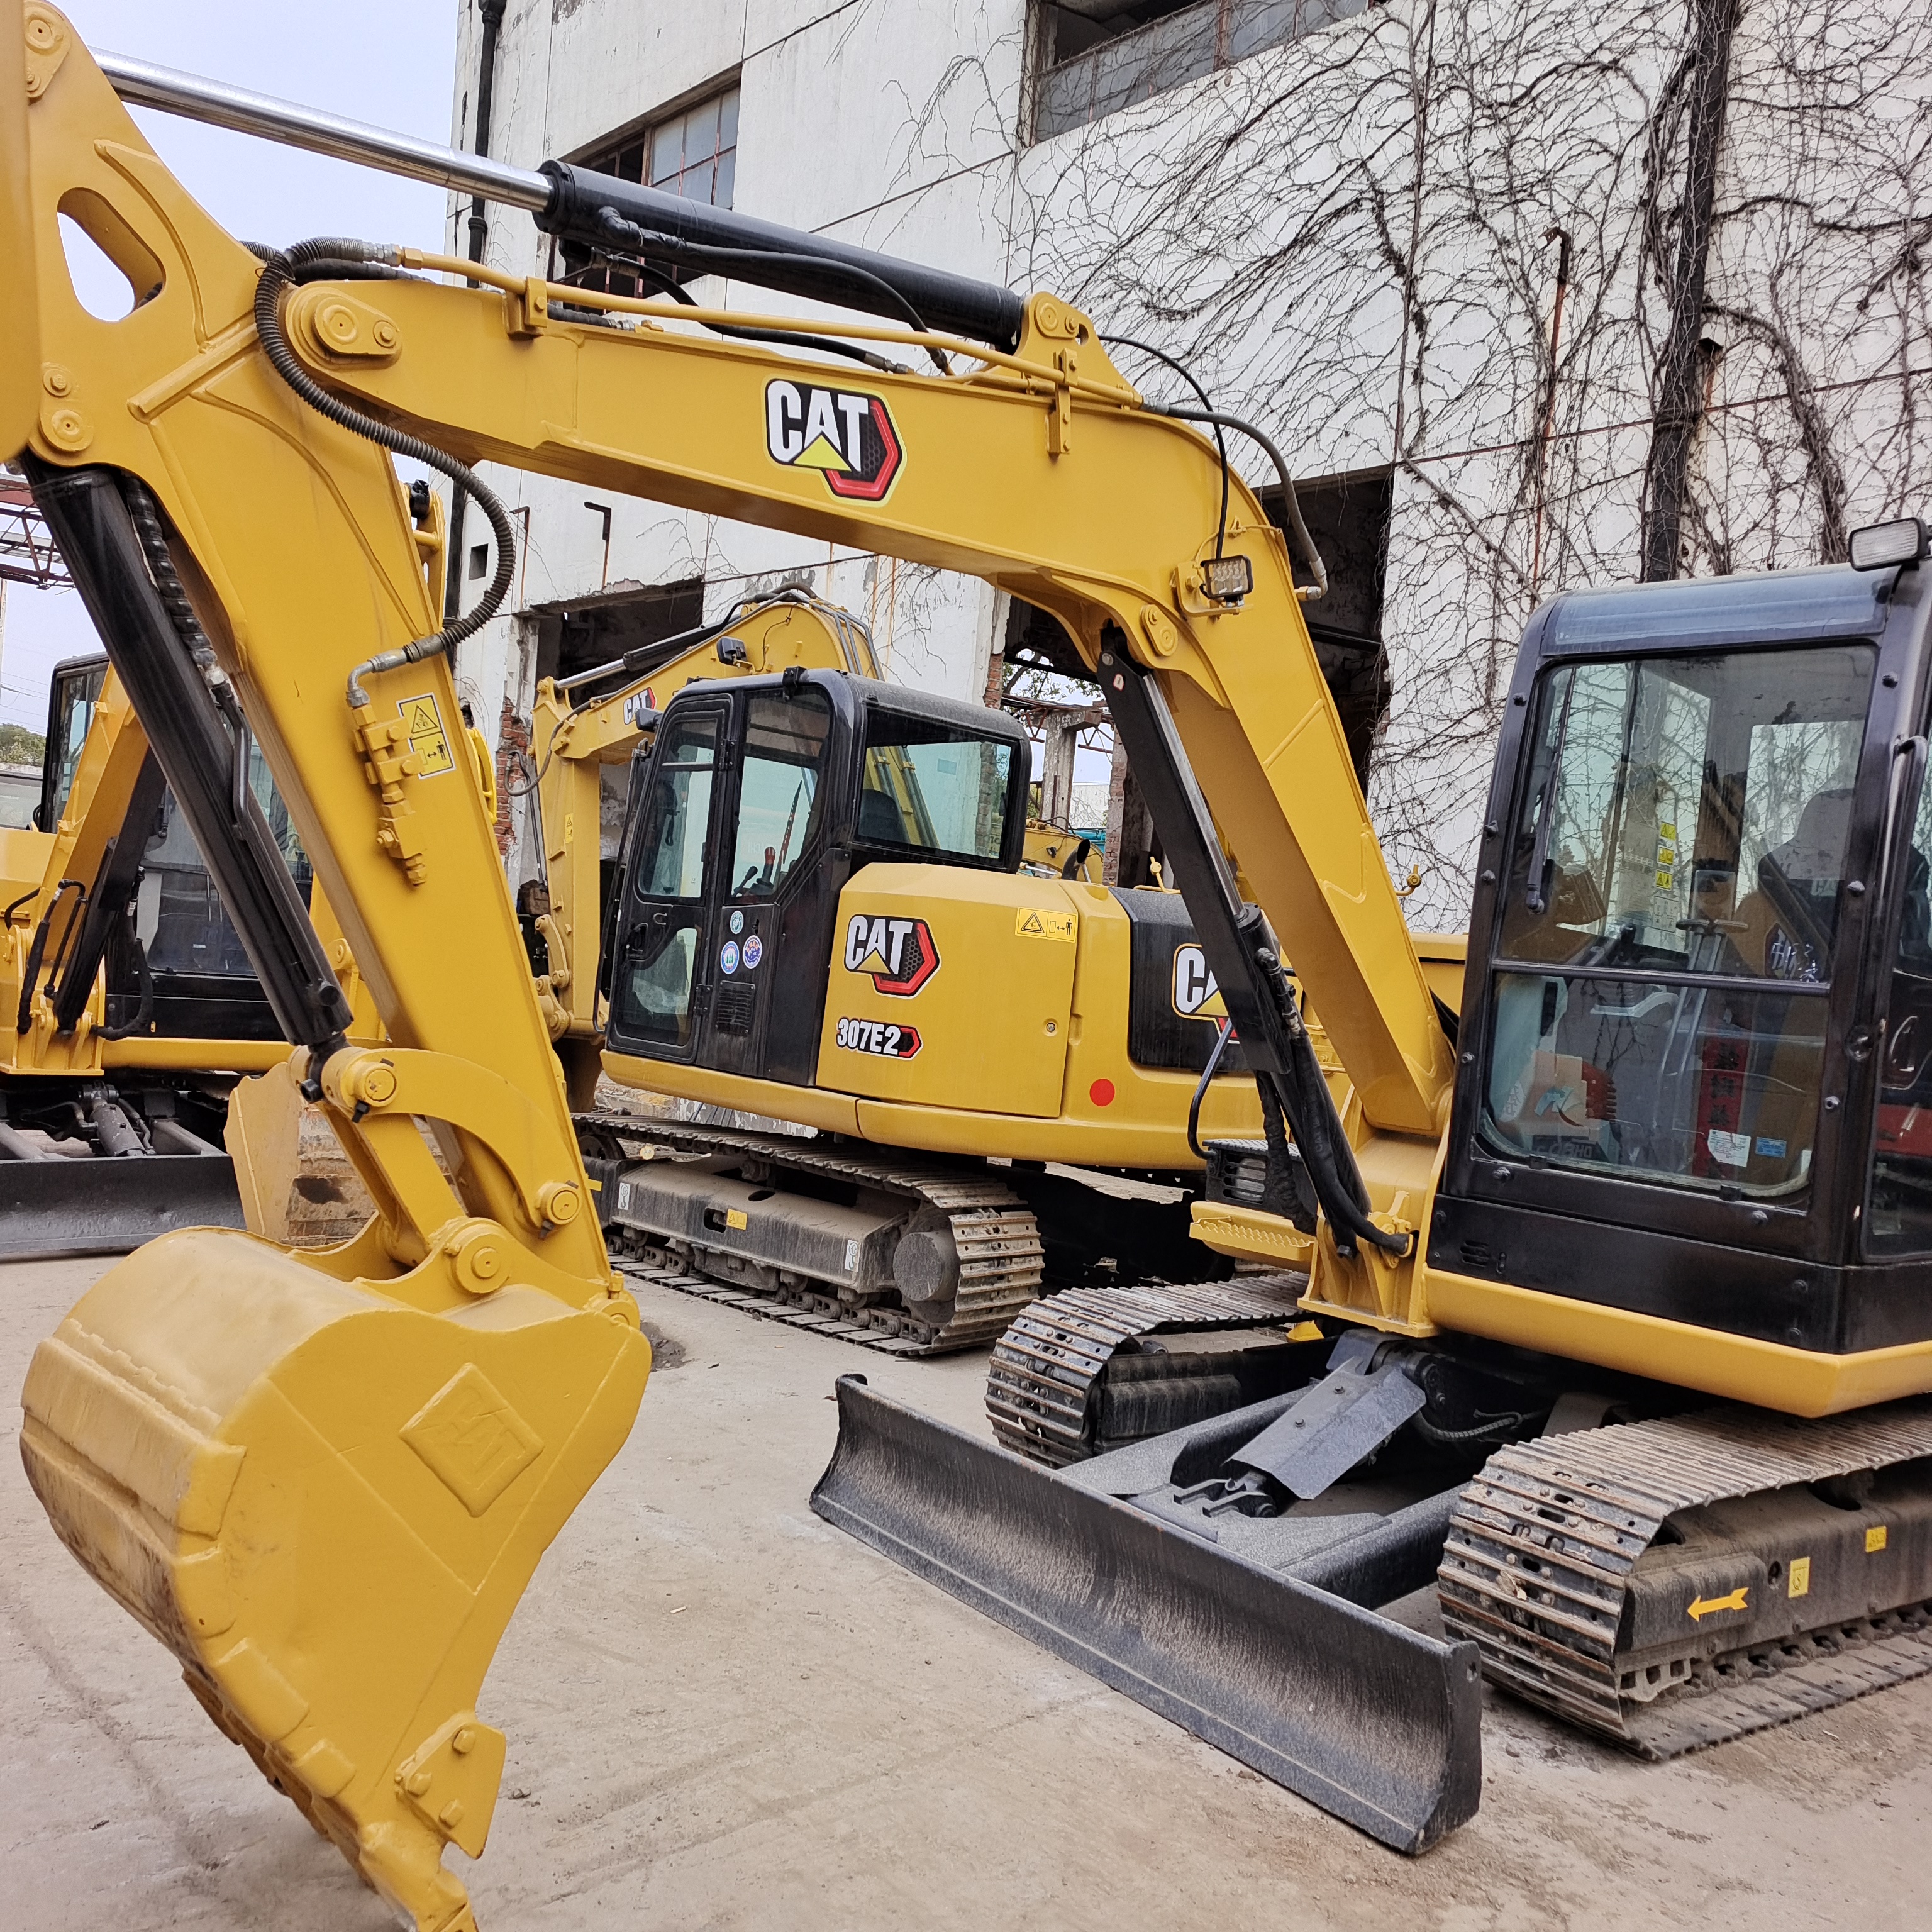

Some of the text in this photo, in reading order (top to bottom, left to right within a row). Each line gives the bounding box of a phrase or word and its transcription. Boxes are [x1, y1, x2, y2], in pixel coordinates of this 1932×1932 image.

[767, 380, 869, 472] CAT
[623, 689, 648, 724] CAT
[1811, 879, 1837, 896] CA
[846, 915, 913, 975] CAT
[837, 1018, 901, 1055] 307E2
